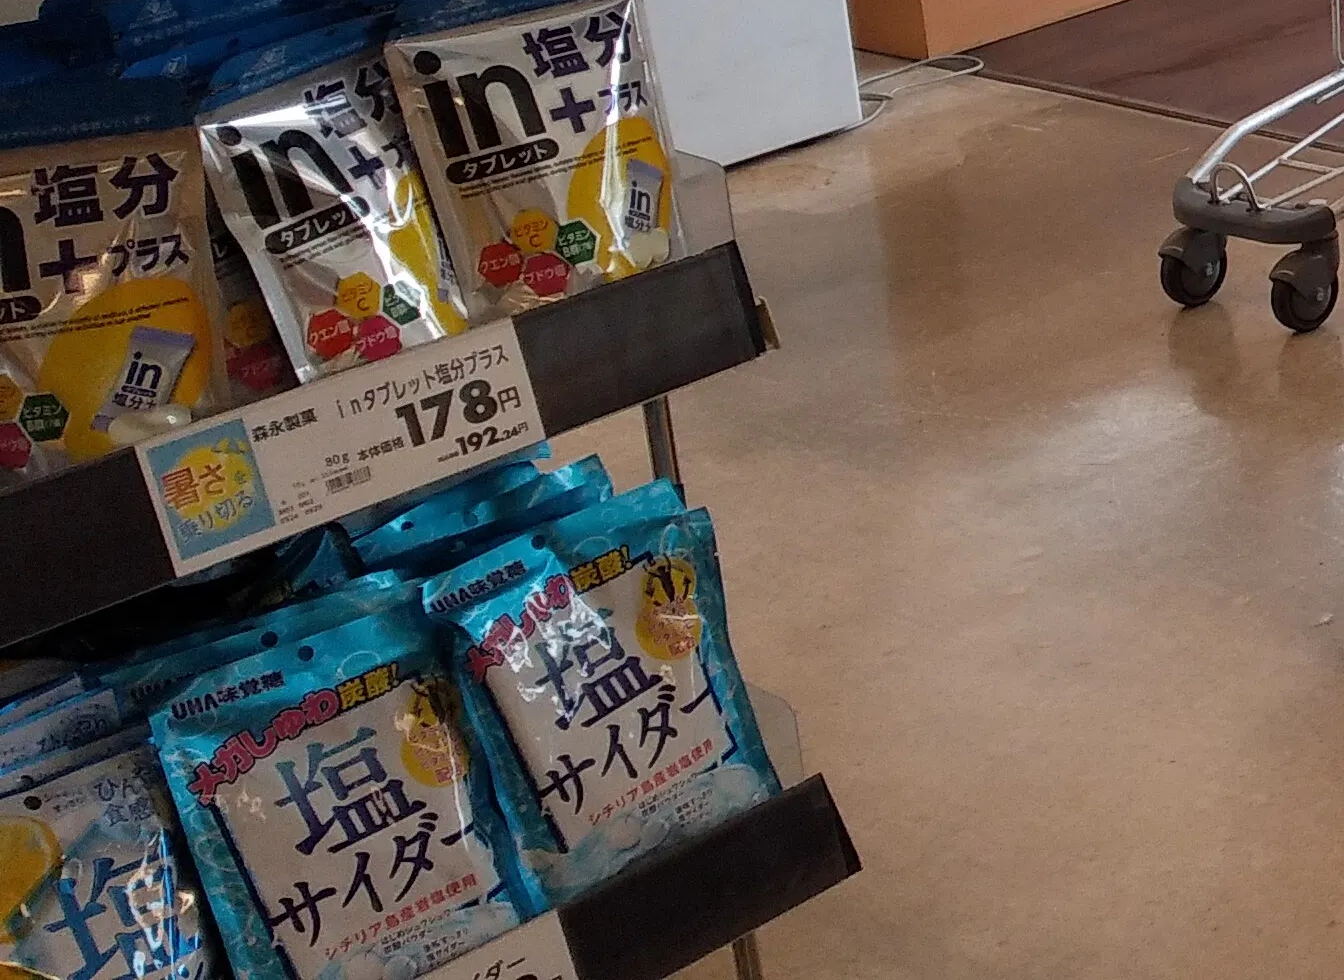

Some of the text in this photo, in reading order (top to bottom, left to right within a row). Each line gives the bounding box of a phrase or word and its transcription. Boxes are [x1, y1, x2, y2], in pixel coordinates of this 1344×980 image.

[522, 11, 633, 79] 塩分
[413, 50, 547, 158] in
[218, 125, 354, 229] in
[462, 144, 549, 177] タブレット
[31, 152, 181, 227] 塩分
[628, 181, 651, 211] in
[513, 218, 548, 238] ビタミン
[529, 232, 543, 247] C
[556, 228, 590, 246] ビタミン
[109, 234, 189, 275] プラス
[480, 255, 522, 274] クエン酸
[525, 262, 570, 286] ブドウ糖
[343, 284, 373, 302] ビタミン
[309, 326, 350, 343] クエン酸
[356, 328, 398, 350] ブドウ糖
[127, 351, 162, 390] in
[252, 345, 510, 443] 森永製菓 inタブレット塩分プラス
[356, 435, 405, 462] 本体価格
[395, 378, 522, 447] 178円
[162, 461, 227, 509] 暑さ
[430, 559, 527, 613] UHA味覚糖
[537, 608, 661, 731] 塩
[170, 670, 285, 720] UHA味覚糖
[539, 685, 715, 815] サイダー
[275, 726, 426, 855] 塩
[588, 738, 713, 826] シチリア島産岩塩使用
[268, 812, 475, 947] サイダー
[325, 874, 478, 960] シチリア島産岩塩使用
